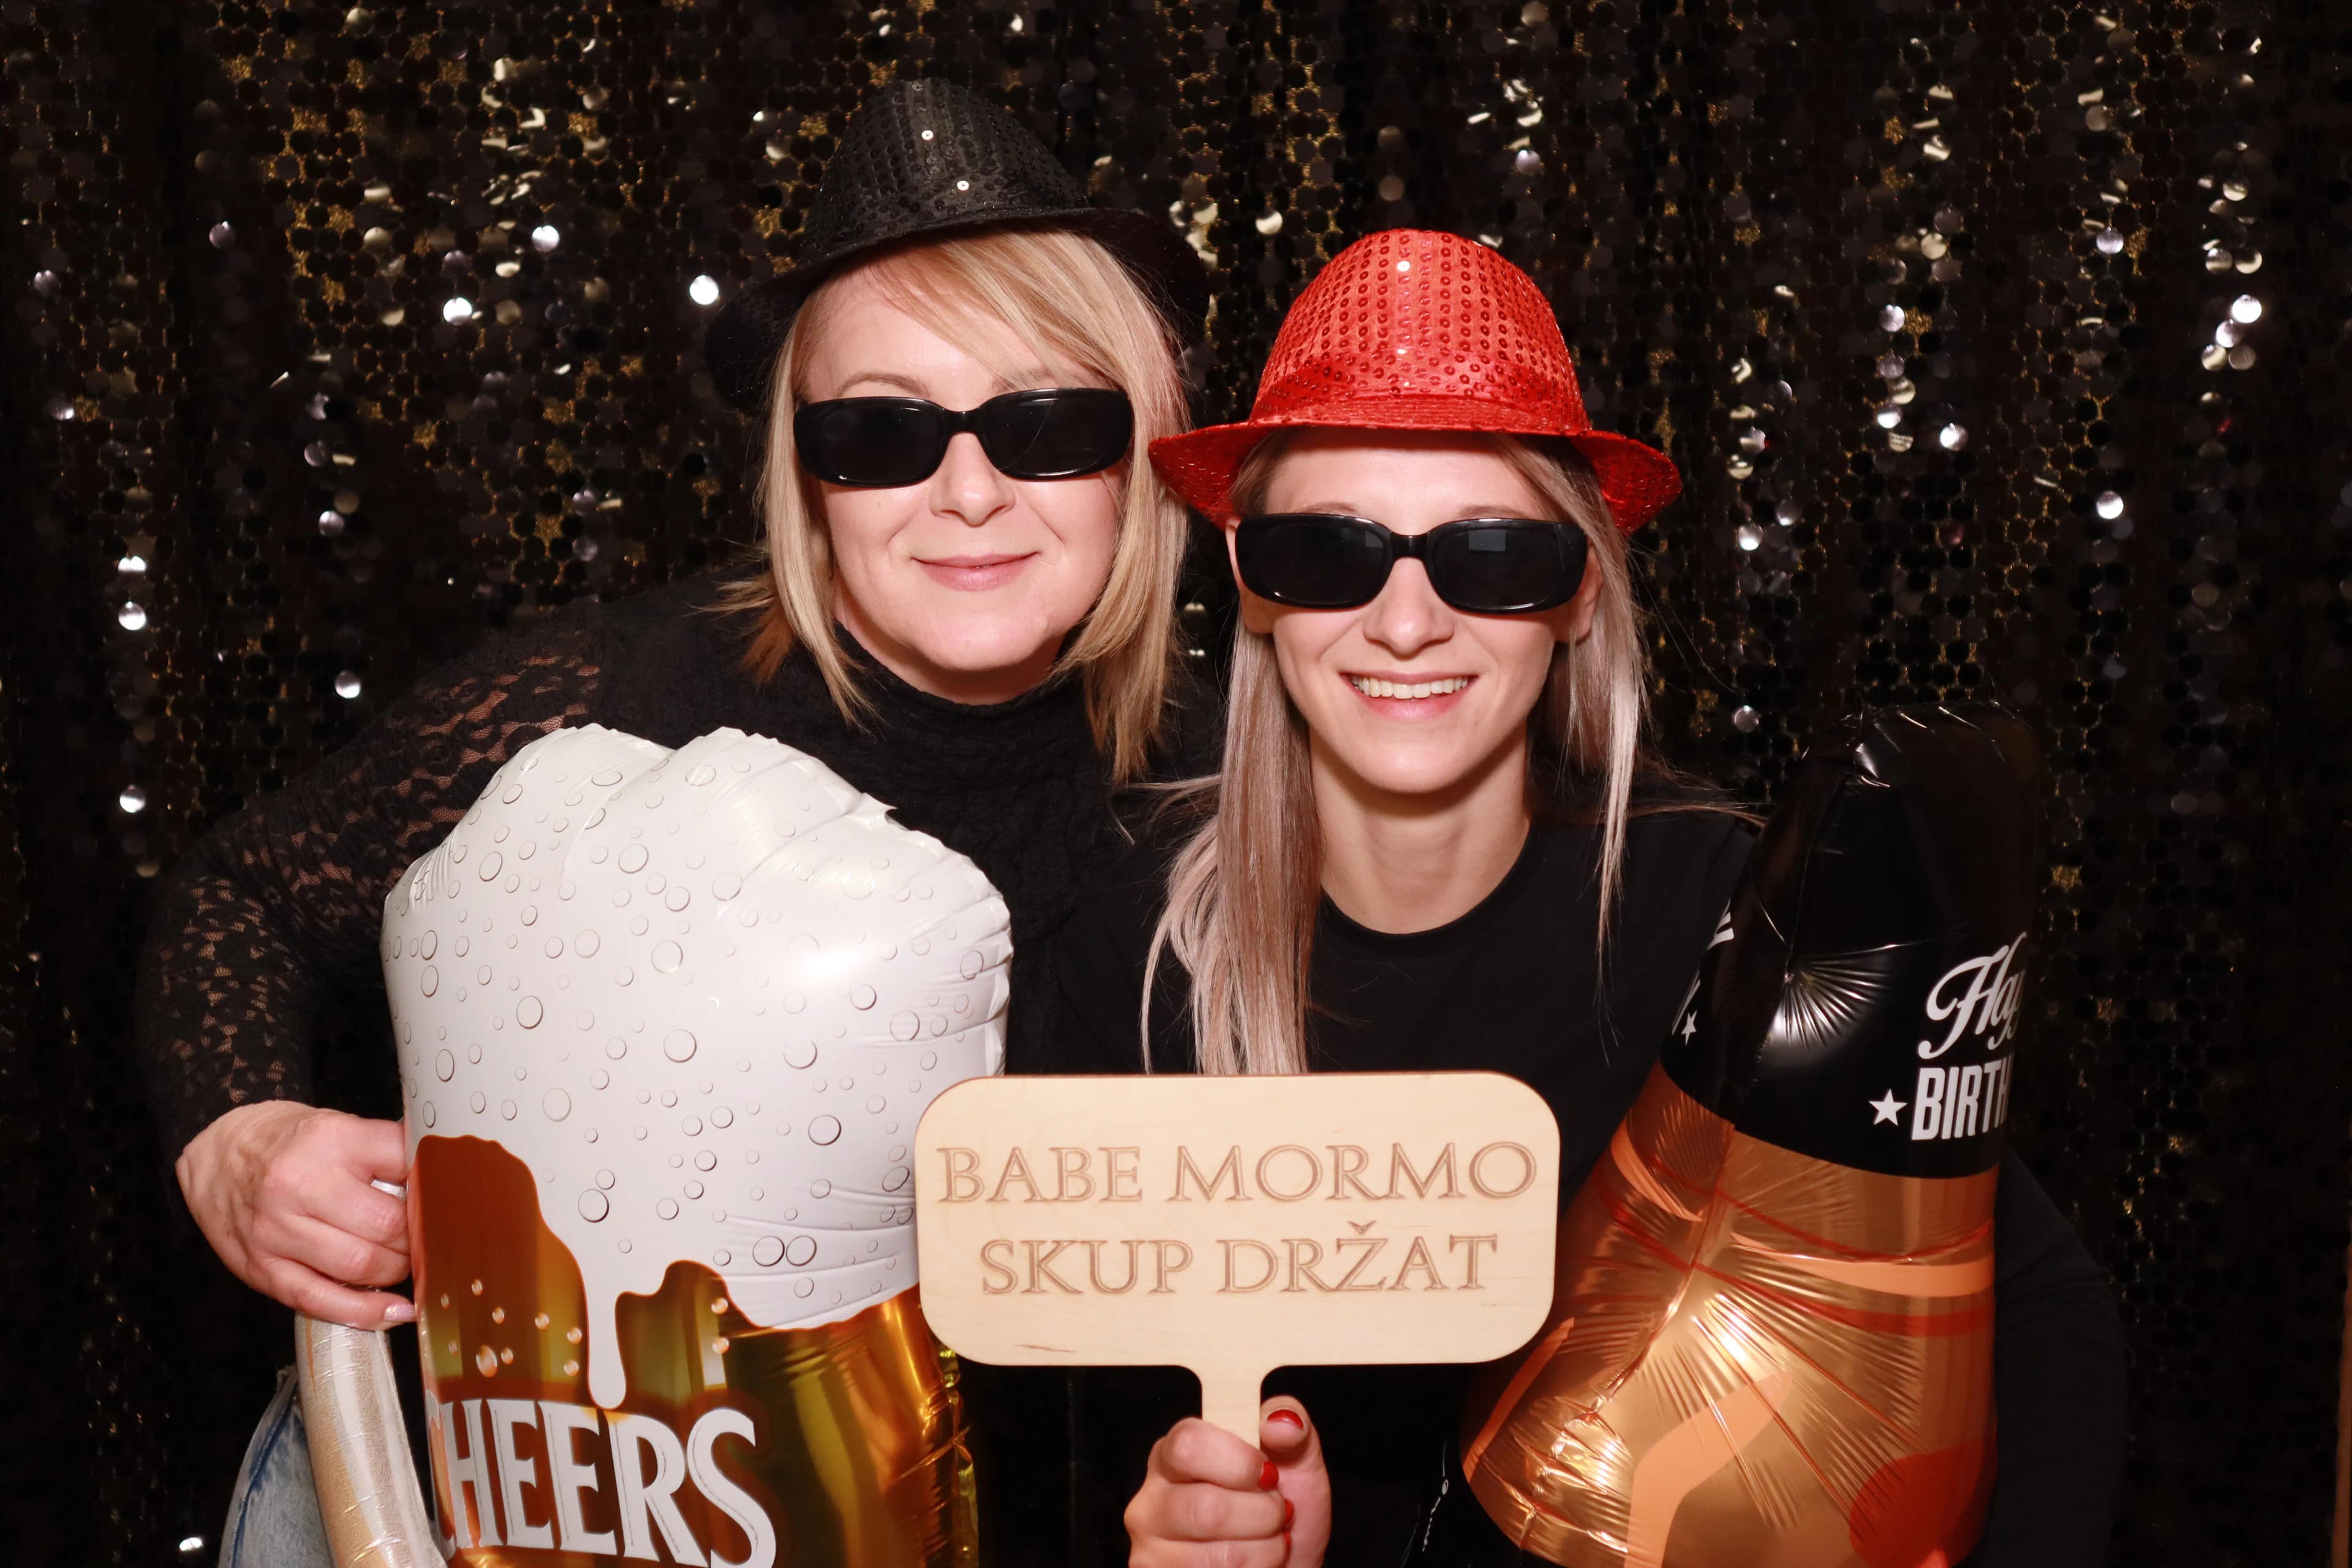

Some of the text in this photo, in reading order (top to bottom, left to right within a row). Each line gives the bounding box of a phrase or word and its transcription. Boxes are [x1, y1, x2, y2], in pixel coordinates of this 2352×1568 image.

[1911, 1054, 2014, 1141] BIRTH
[937, 1140, 1538, 1204] BABE MORMO
[979, 1219, 1499, 1296] SKUP DRŽAT
